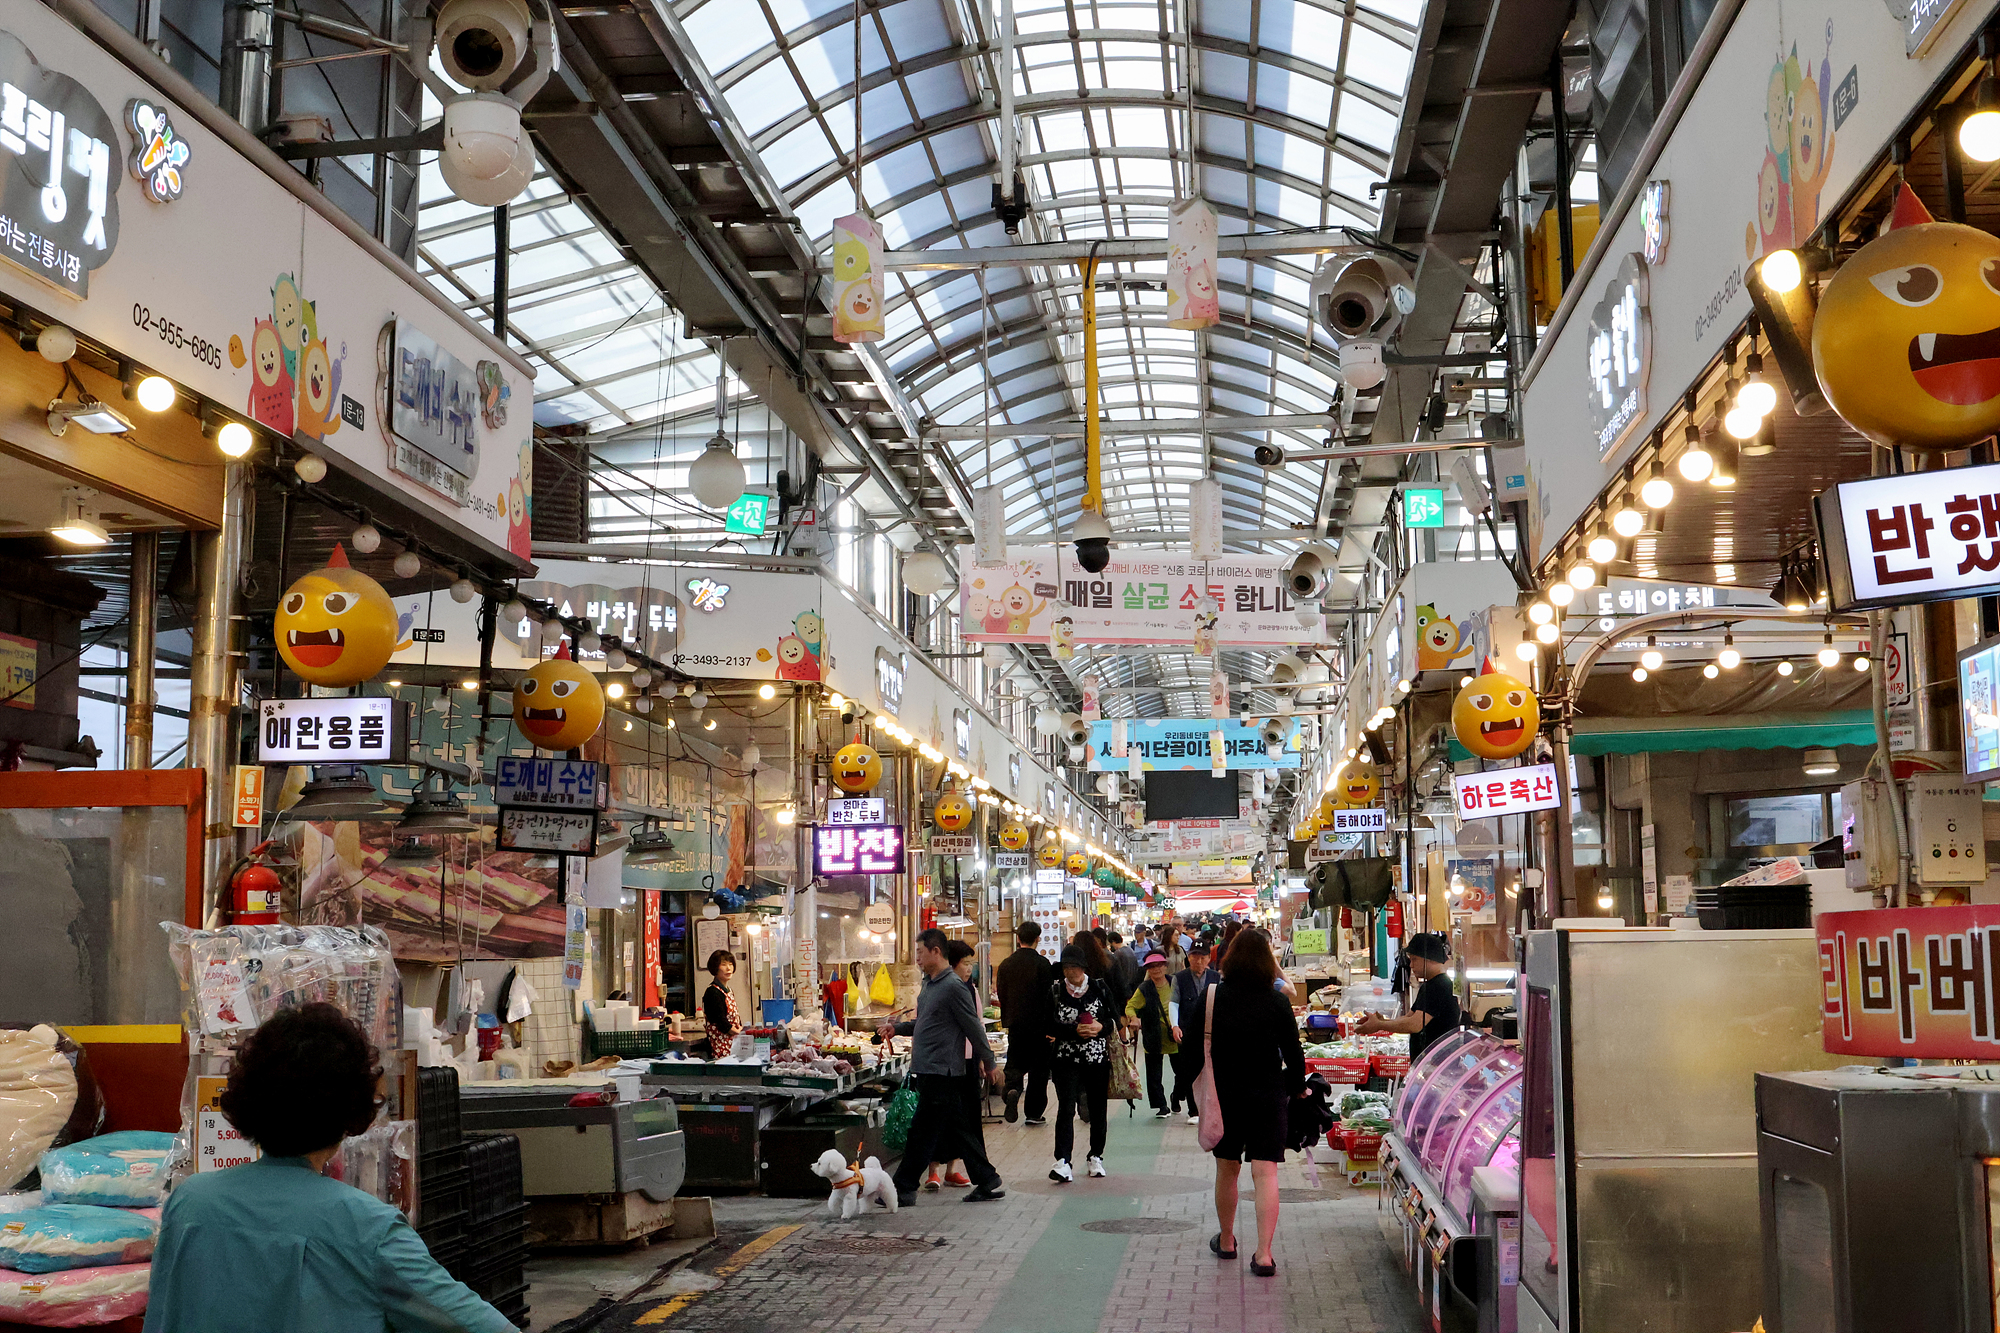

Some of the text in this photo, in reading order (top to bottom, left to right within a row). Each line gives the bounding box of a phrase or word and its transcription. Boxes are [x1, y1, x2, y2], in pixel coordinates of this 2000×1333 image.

[1835, 75, 1857, 120] 1문-6
[28, 231, 81, 282] 전통시장
[1695, 263, 1741, 342] 02-3493-5024
[133, 302, 222, 370] 02-955-6805
[342, 400, 364, 426] 1문-13
[466, 491, 498, 522] 2-3491-9571
[1132, 564, 1160, 576] 시장은
[1187, 565, 1215, 577] 코로나
[1216, 566, 1253, 578] 바이러스
[1065, 580, 1113, 609] 매일
[1121, 582, 1170, 610] 살균
[1598, 586, 1715, 632] 동해야채
[586, 600, 638, 643] 반찬
[649, 604, 677, 632] 두부
[413, 630, 444, 641] 1문-15
[672, 653, 752, 668] 02-3493-2137
[1887, 681, 1905, 695] 시장
[265, 714, 385, 751] 애완용품
[1164, 731, 1194, 740] 우리동네
[1153, 739, 1202, 759] 단골이
[1204, 738, 1288, 758] 어주세
[499, 759, 553, 792] 도깨비
[559, 762, 596, 795] 수산
[239, 796, 260, 805] 소화기
[540, 791, 575, 804] 생선가게
[1461, 775, 1553, 810] 하은축산
[842, 800, 869, 810] 엄마손
[1336, 813, 1383, 828] 동해야채
[818, 828, 901, 873] 반찬
[932, 837, 973, 848] 생선백화점
[997, 855, 1028, 867] 여천상회
[204, 1119, 215, 1129] 1장
[204, 1145, 216, 1156] 2장
